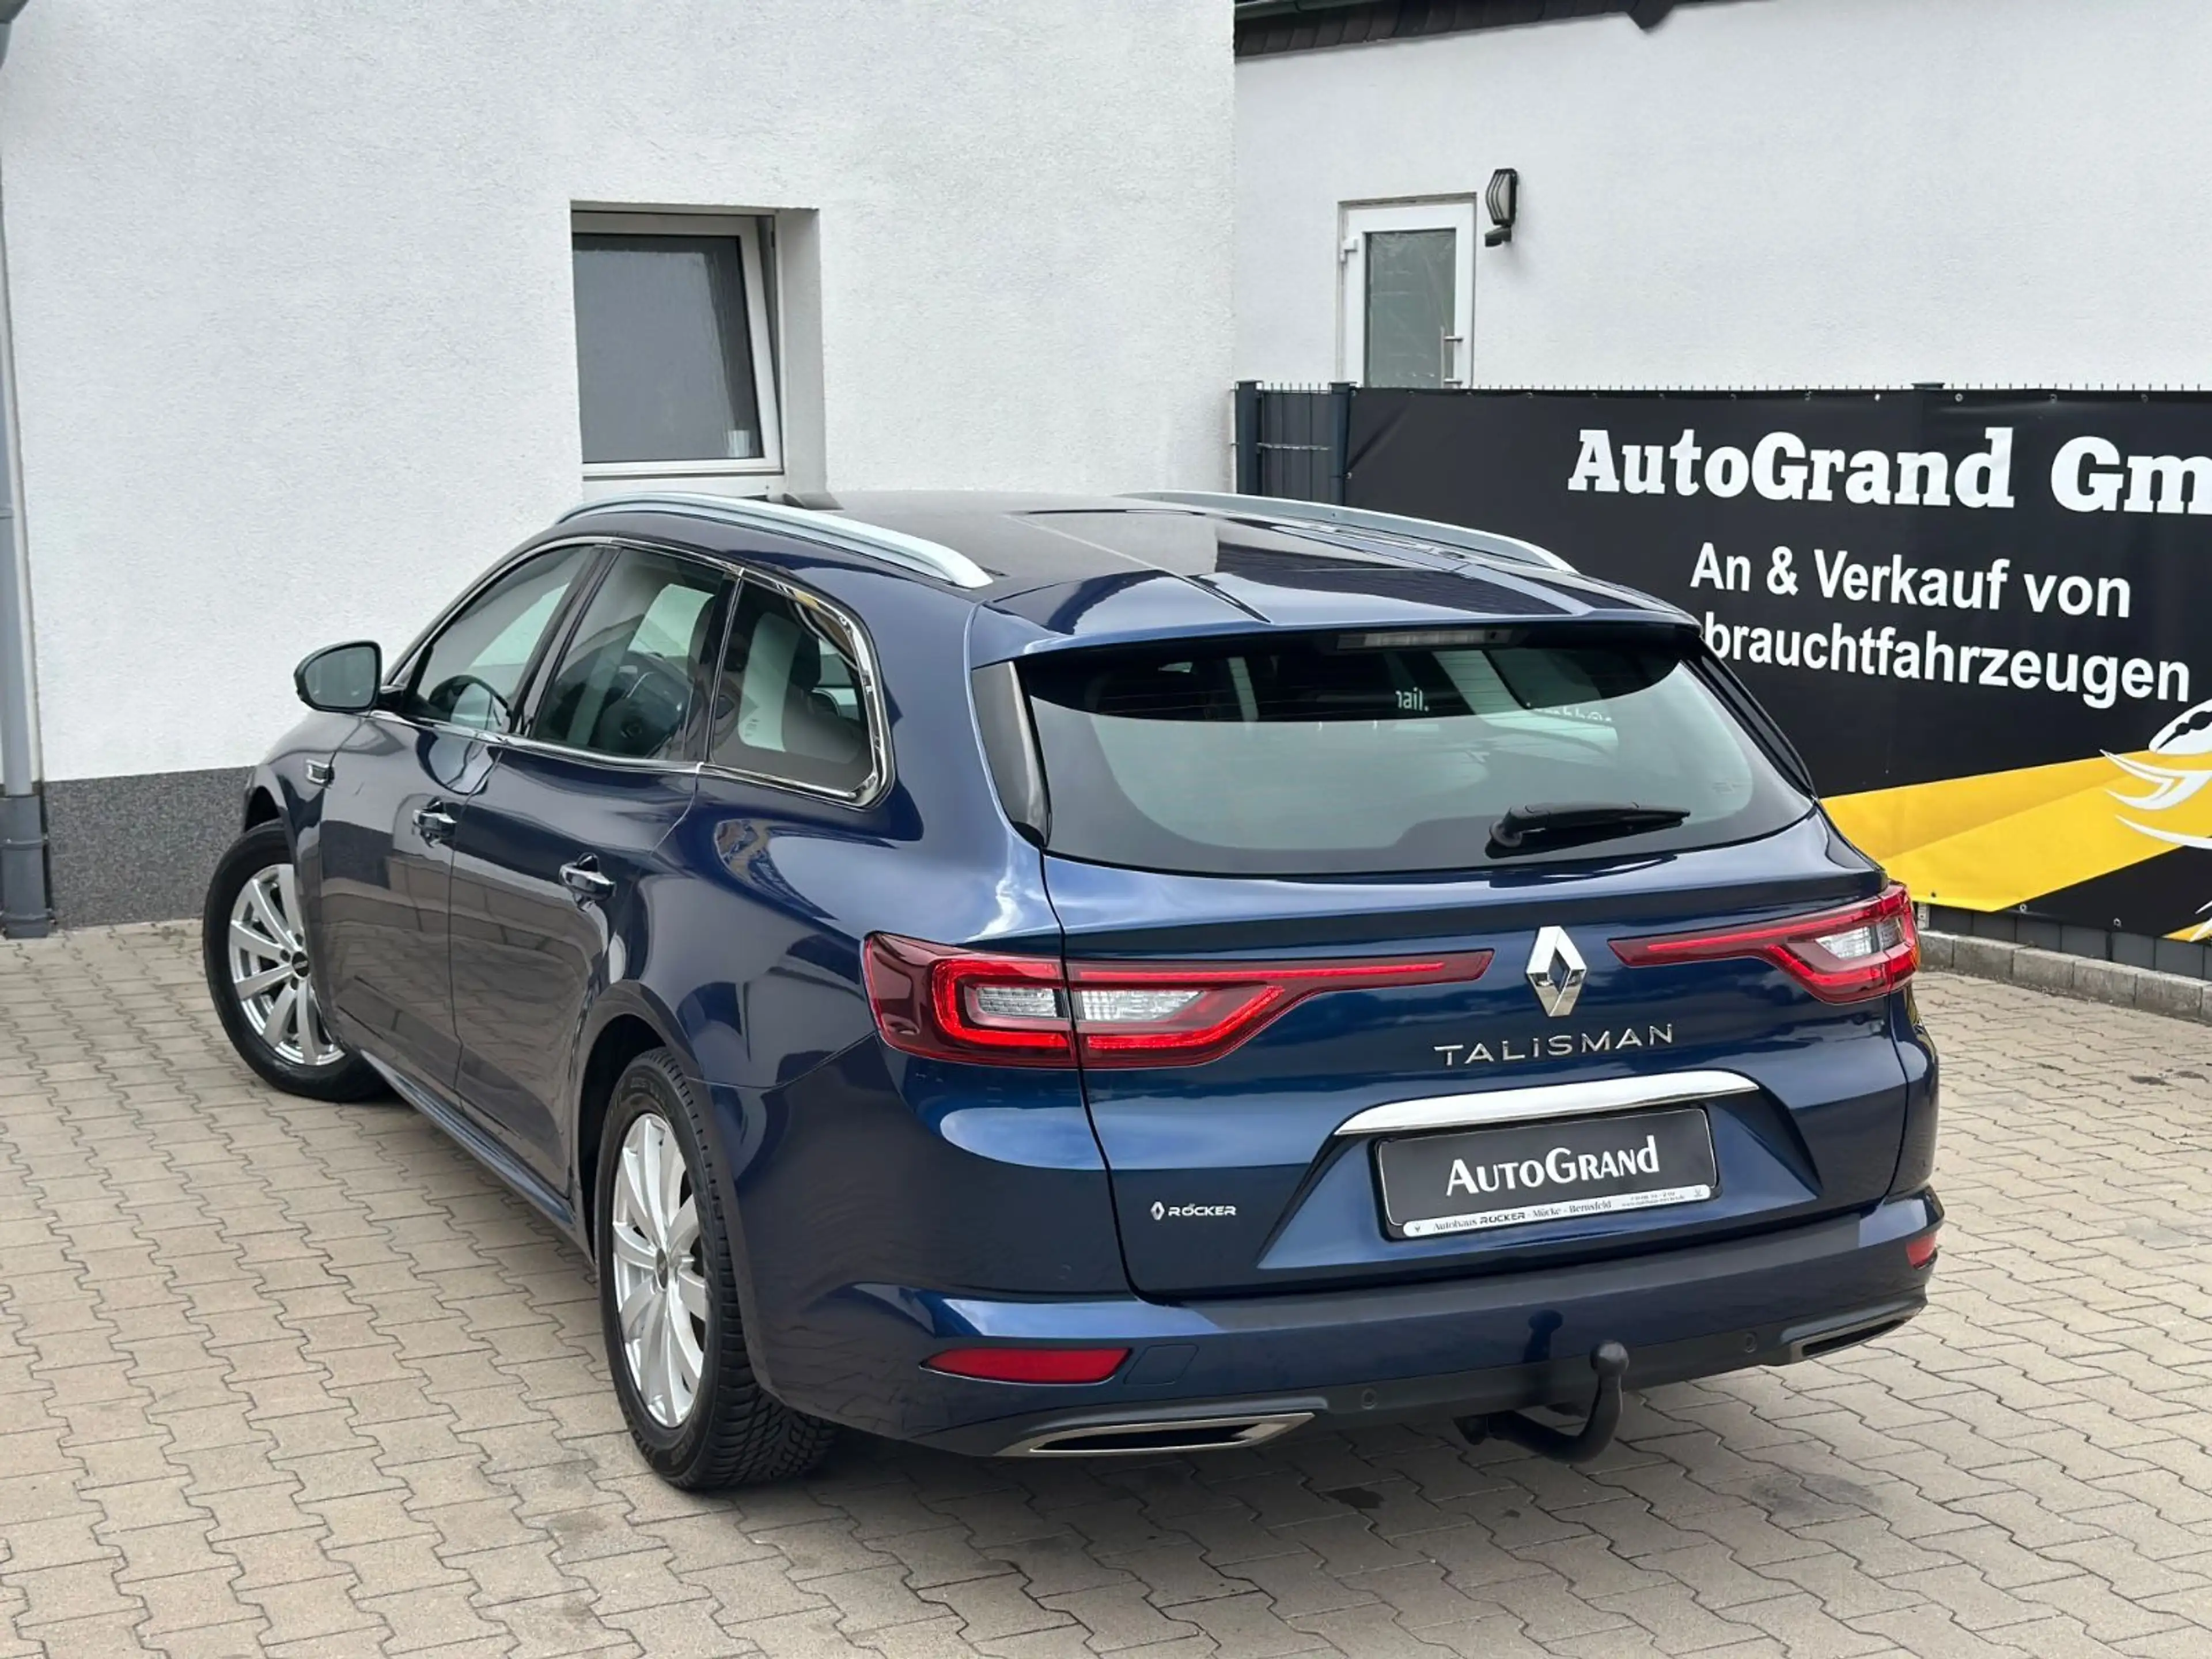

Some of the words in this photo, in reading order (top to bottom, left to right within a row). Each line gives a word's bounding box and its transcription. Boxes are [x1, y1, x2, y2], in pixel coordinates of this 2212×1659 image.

[1567, 427, 2014, 508] AutoGrand
[1690, 542, 1751, 592] An
[1766, 546, 1799, 596] &
[1813, 549, 2011, 610] Verkauf
[2024, 574, 2130, 618] von
